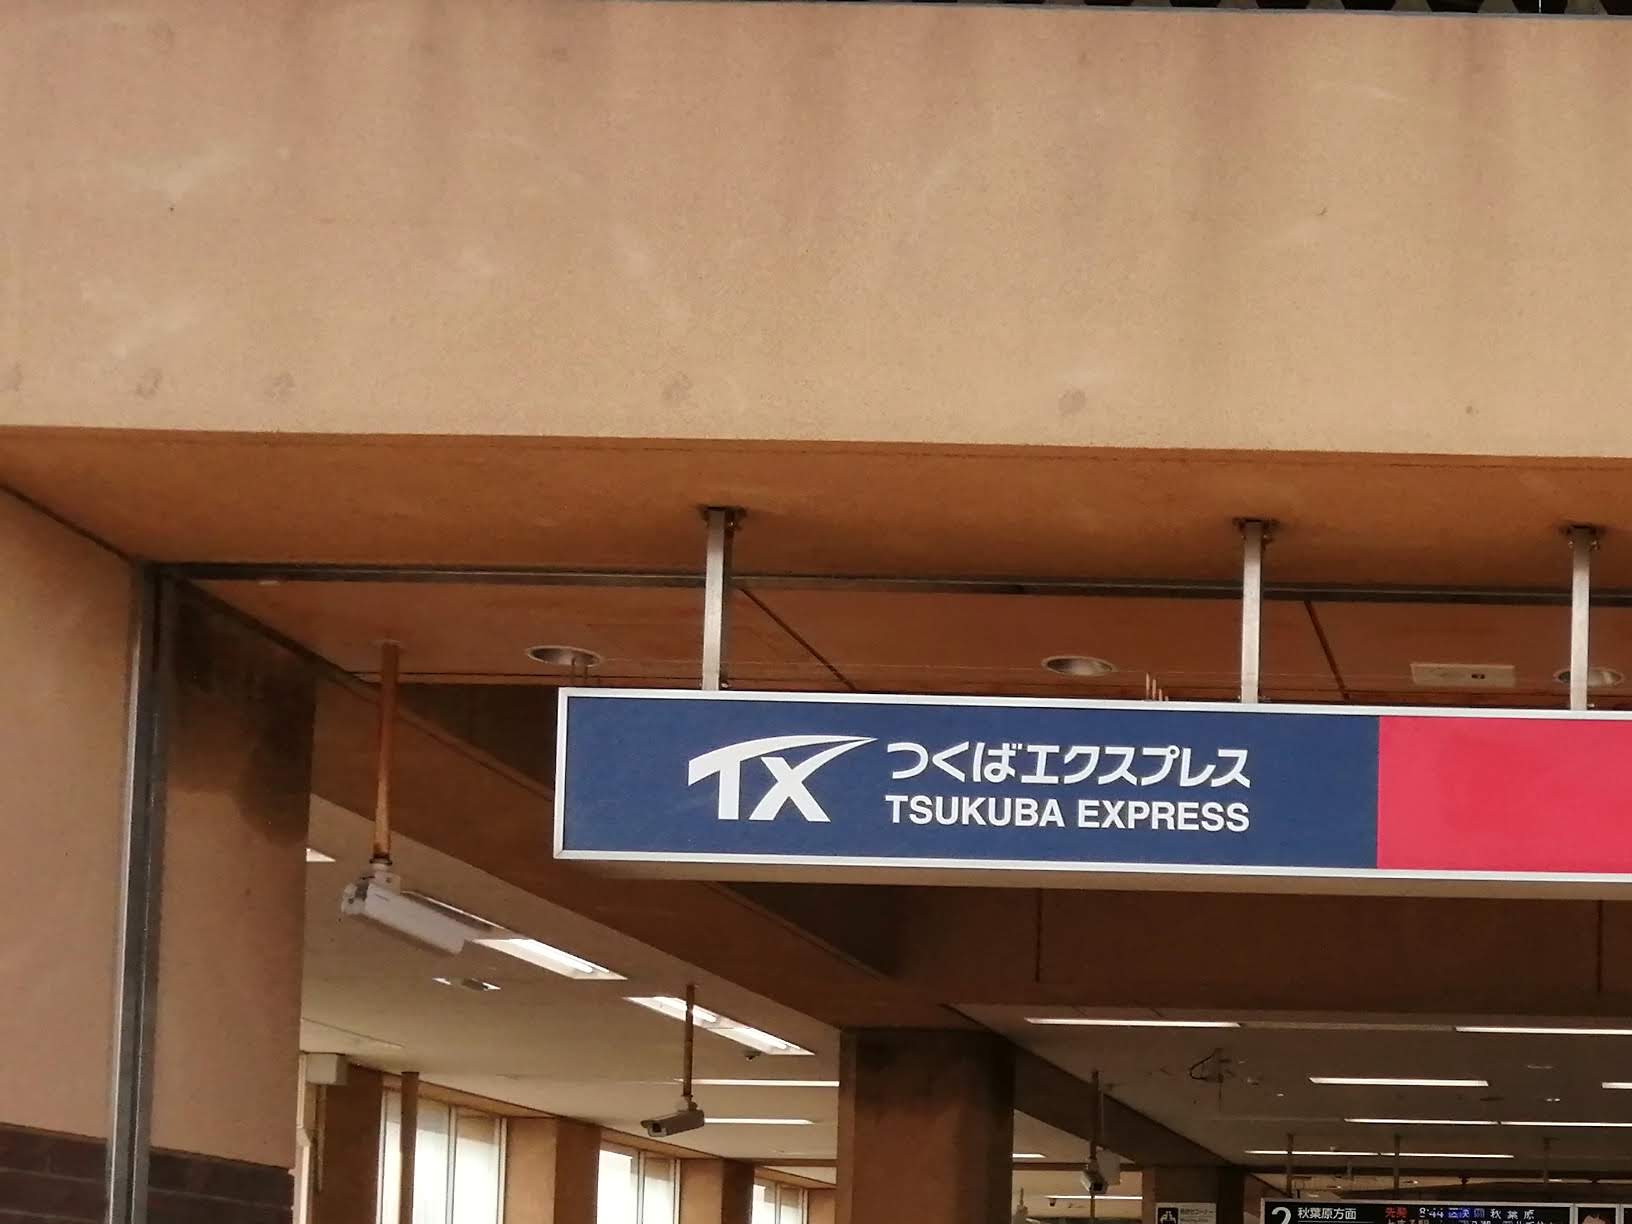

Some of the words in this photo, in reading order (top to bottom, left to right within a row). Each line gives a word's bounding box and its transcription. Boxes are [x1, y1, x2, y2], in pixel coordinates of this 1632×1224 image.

[688, 735, 877, 822] TX
[887, 741, 1251, 789] つくばエクスプレス
[885, 795, 1064, 829] TSUKUBA
[1077, 799, 1251, 833] EXPRESS
[1297, 1207, 1357, 1220] 秋葉原方面
